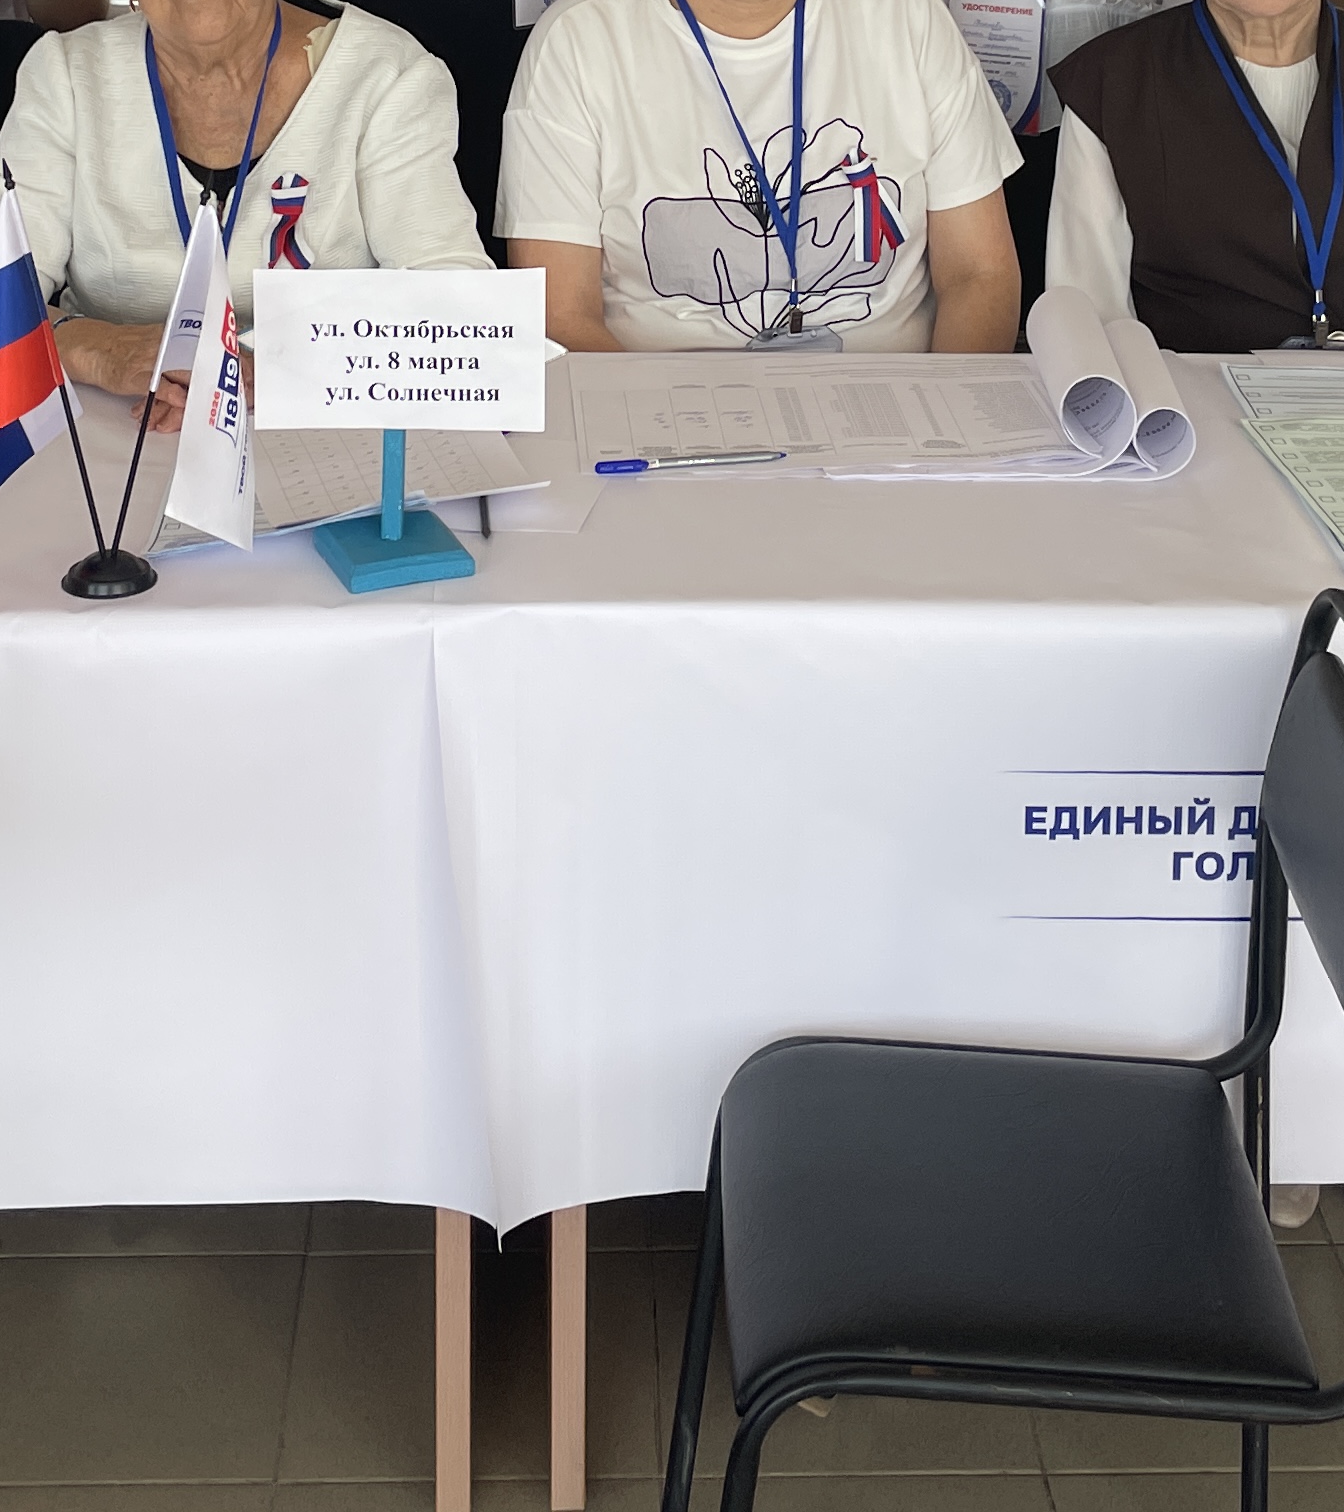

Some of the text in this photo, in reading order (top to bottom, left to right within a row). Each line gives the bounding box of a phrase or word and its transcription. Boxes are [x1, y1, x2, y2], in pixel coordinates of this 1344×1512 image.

[961, 2, 1034, 16] УДОСТОВЕРЕНИЕ
[179, 319, 203, 330] ТВО
[310, 318, 514, 343] ул. Октябрьская
[224, 357, 238, 388] 19
[345, 351, 481, 375] ул. 8 марта
[325, 382, 501, 406] ул. Солнечная
[209, 391, 221, 427] 2026
[224, 398, 238, 428] 18
[1023, 797, 1216, 841] ЕДИНЫЙ
